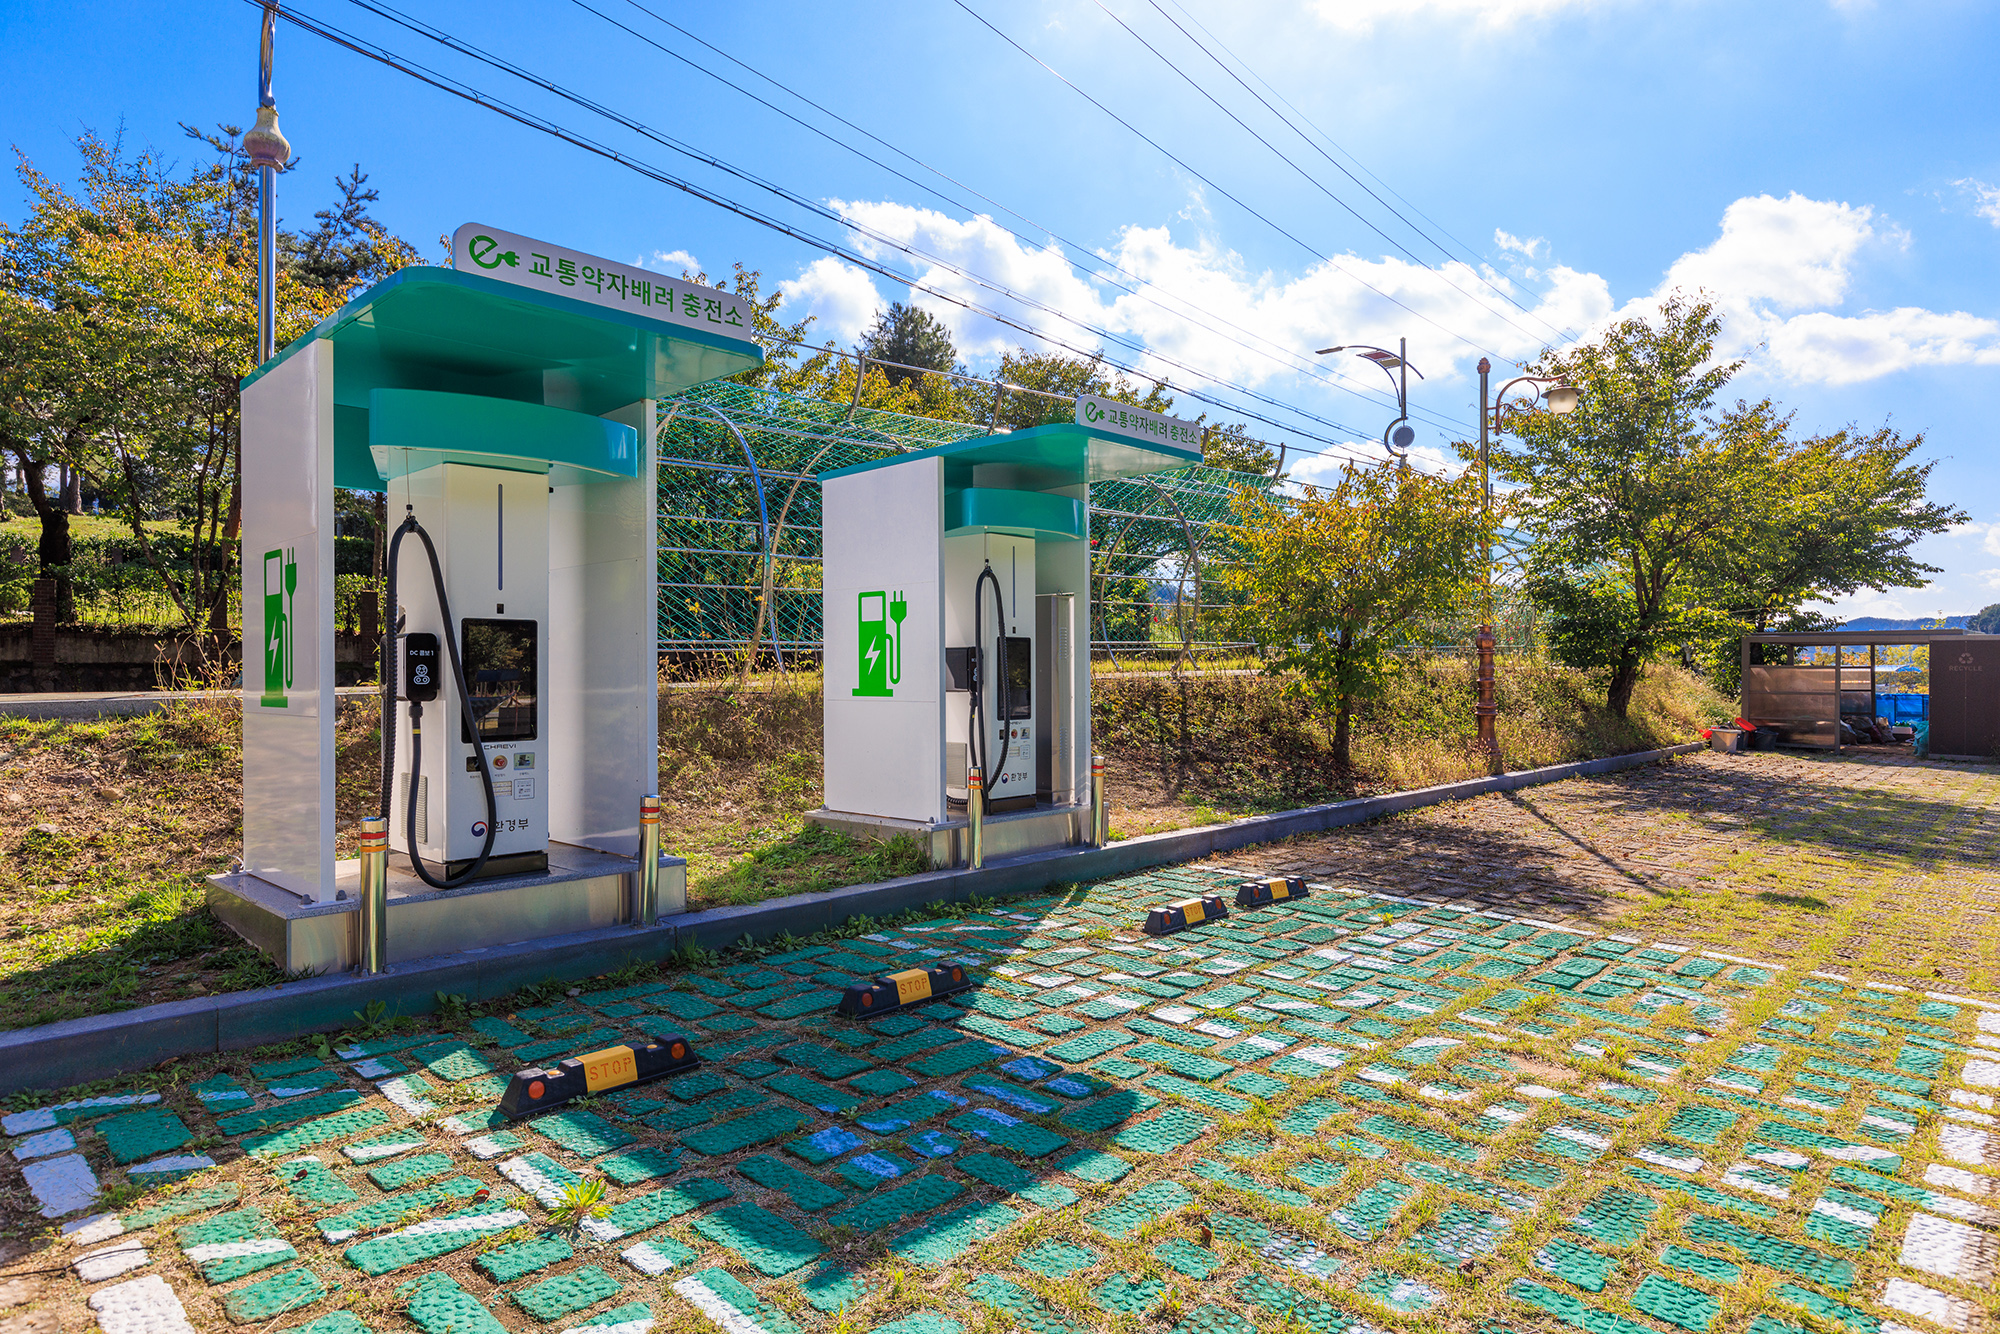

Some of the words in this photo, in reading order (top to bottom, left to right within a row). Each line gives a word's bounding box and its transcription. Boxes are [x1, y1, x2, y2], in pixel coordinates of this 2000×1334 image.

[528, 252, 674, 313] 교통약자배려
[681, 292, 744, 328] 충전소
[1108, 409, 1168, 439] 교통약자배려
[1170, 425, 1197, 444] 충전소
[1011, 772, 1028, 781] 환경부
[1272, 883, 1285, 893] STOP
[1185, 905, 1202, 917] STOP
[900, 977, 928, 995] STOP
[589, 1057, 631, 1081] STOP
